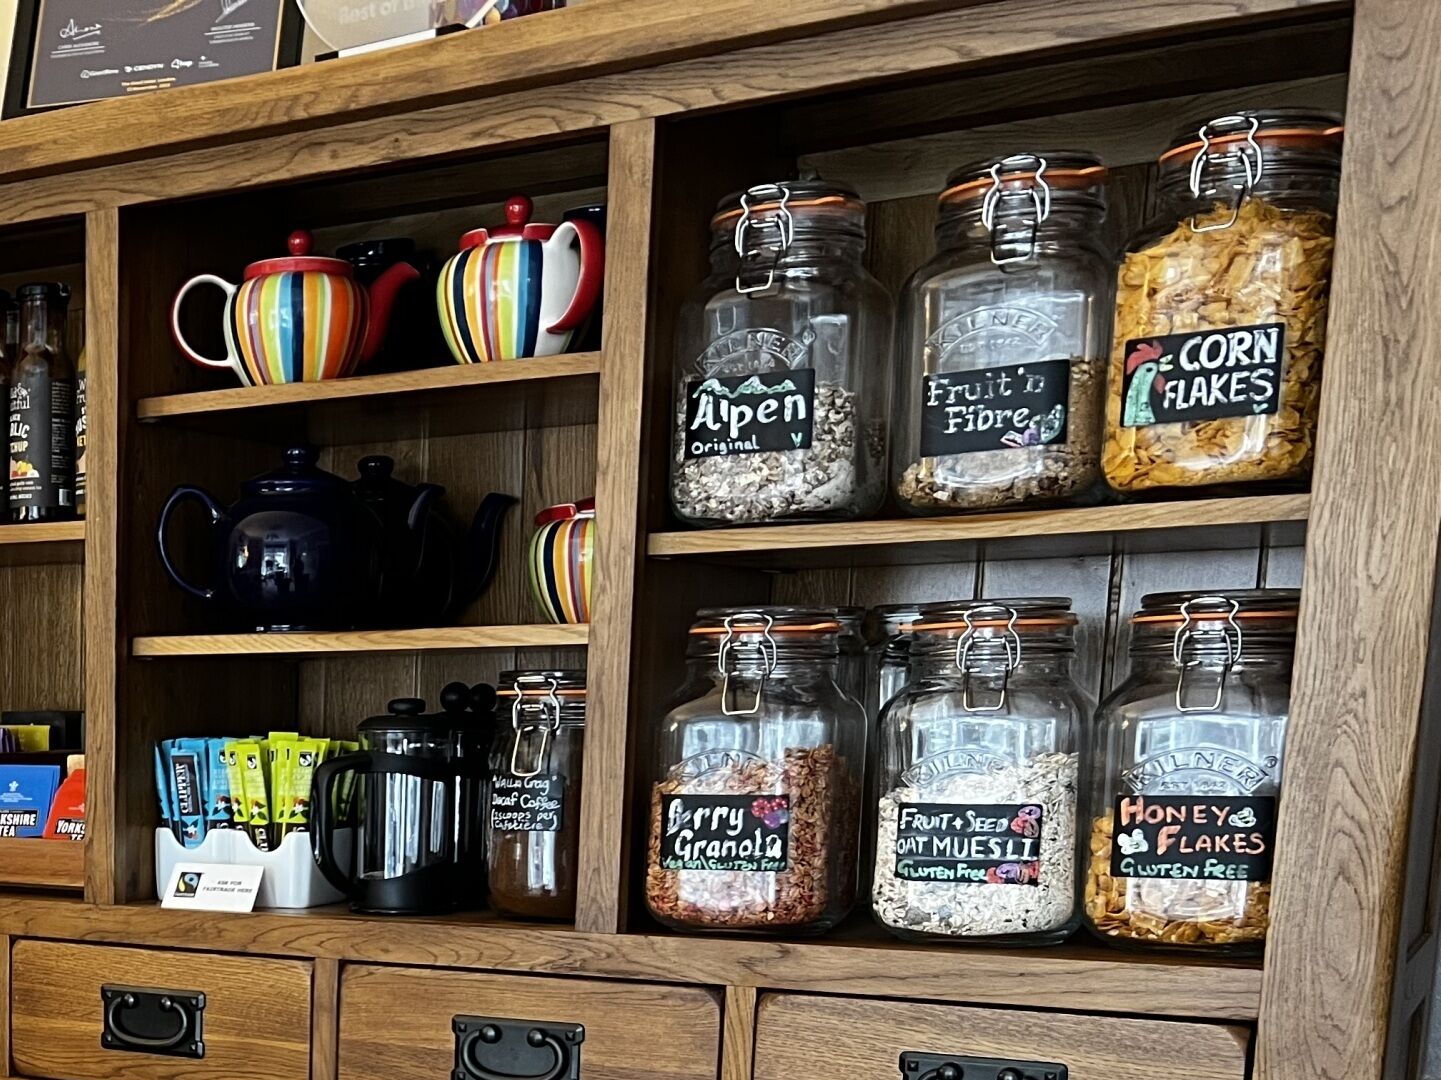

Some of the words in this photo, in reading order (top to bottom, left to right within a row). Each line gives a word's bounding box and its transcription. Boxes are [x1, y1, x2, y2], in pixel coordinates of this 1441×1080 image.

[1179, 327, 1280, 371] CORN
[926, 371, 1013, 407] Fruit
[1163, 367, 1274, 411] FLAKES
[690, 392, 807, 440] Alpen
[943, 404, 1030, 434] Fibre
[691, 434, 761, 455] Original
[1129, 752, 1260, 790] KILNER
[175, 763, 190, 814] CLIPPER
[666, 798, 744, 837] Berry
[899, 807, 954, 832] FRUIT
[965, 810, 1009, 833] SEED
[1120, 796, 1231, 827] HONEY
[674, 827, 783, 861] Granola
[896, 836, 928, 855] OAT
[1157, 825, 1266, 856] FLAKES
[1120, 857, 1200, 879] GLUTEN
[1204, 858, 1249, 879] FREE
